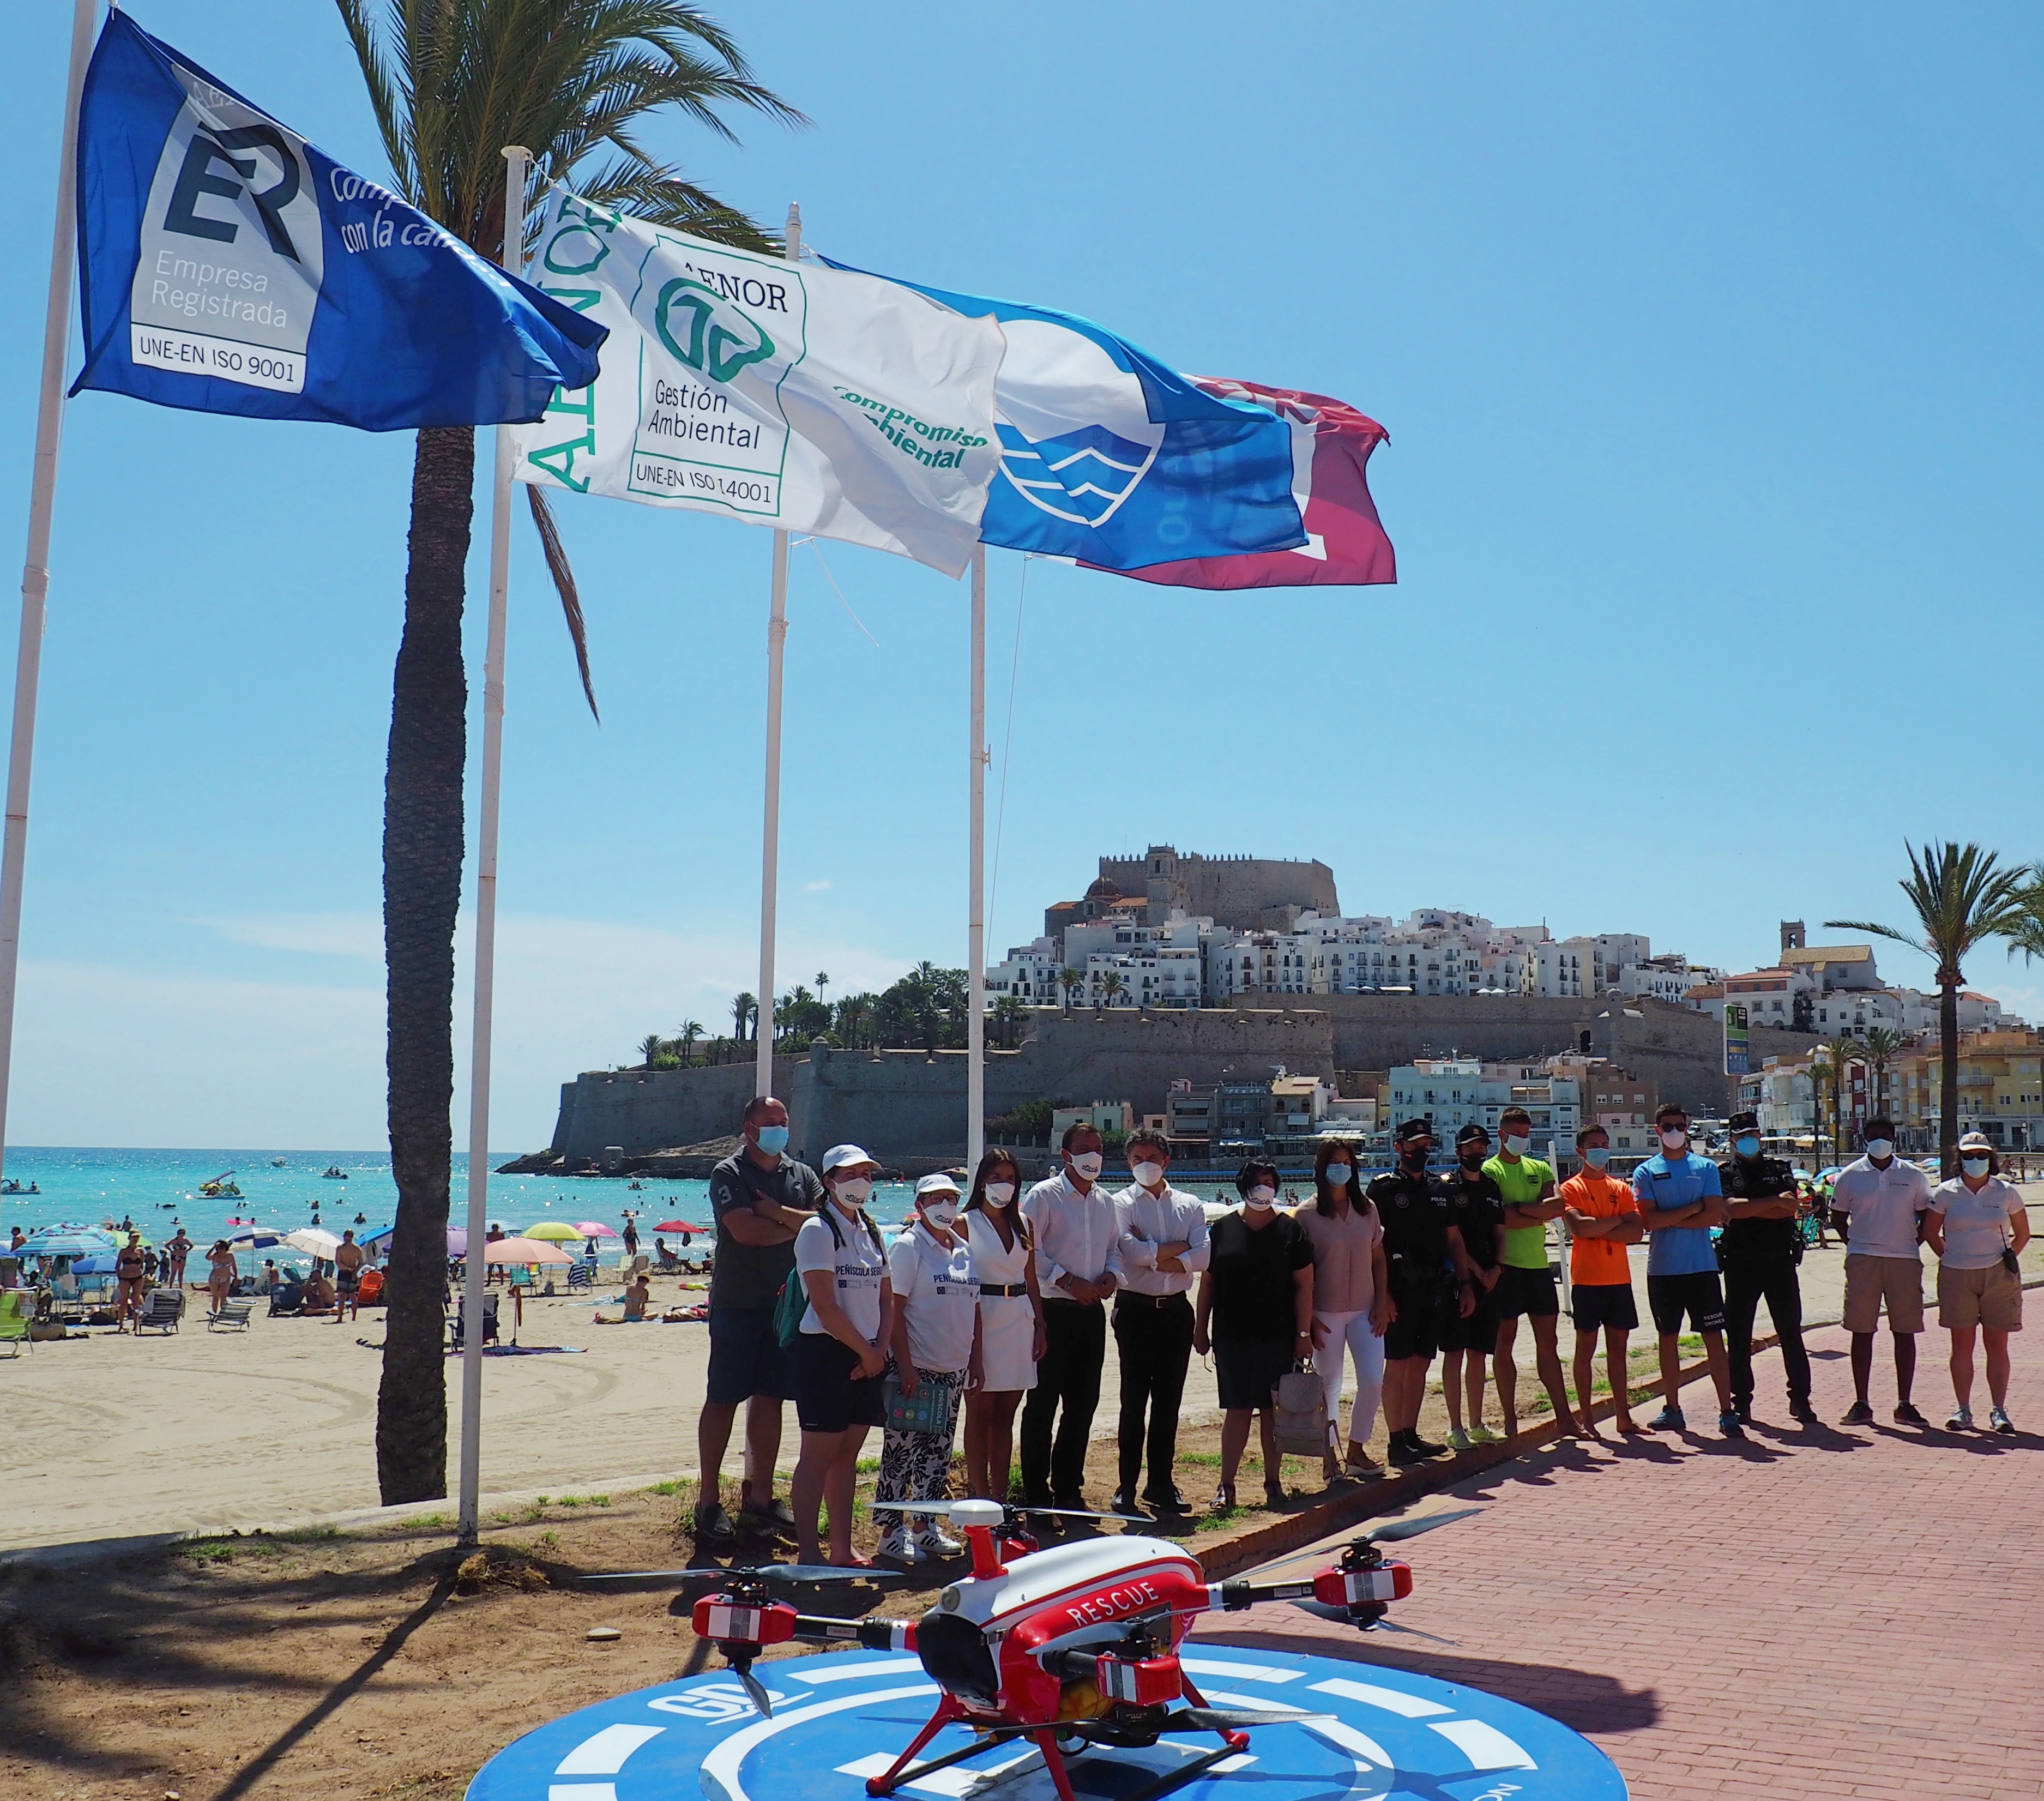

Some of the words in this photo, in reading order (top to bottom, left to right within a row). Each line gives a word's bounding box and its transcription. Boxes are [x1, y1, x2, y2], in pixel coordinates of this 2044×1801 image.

[163, 121, 302, 264] ER
[341, 221, 369, 254] con
[373, 209, 394, 249] la
[156, 250, 268, 293] Empresa
[152, 279, 287, 328] Registrada
[141, 336, 205, 365] UNE-EN
[213, 349, 243, 371] ISO
[249, 357, 294, 382] 9001
[655, 380, 727, 413] Gestión
[648, 409, 760, 449] Ambiental
[636, 463, 685, 487] UNE-EN
[689, 472, 715, 490] ISO
[717, 478, 771, 503] 14001
[718, 1184, 732, 1204] 3
[1065, 1581, 1159, 1628] RESCUE
